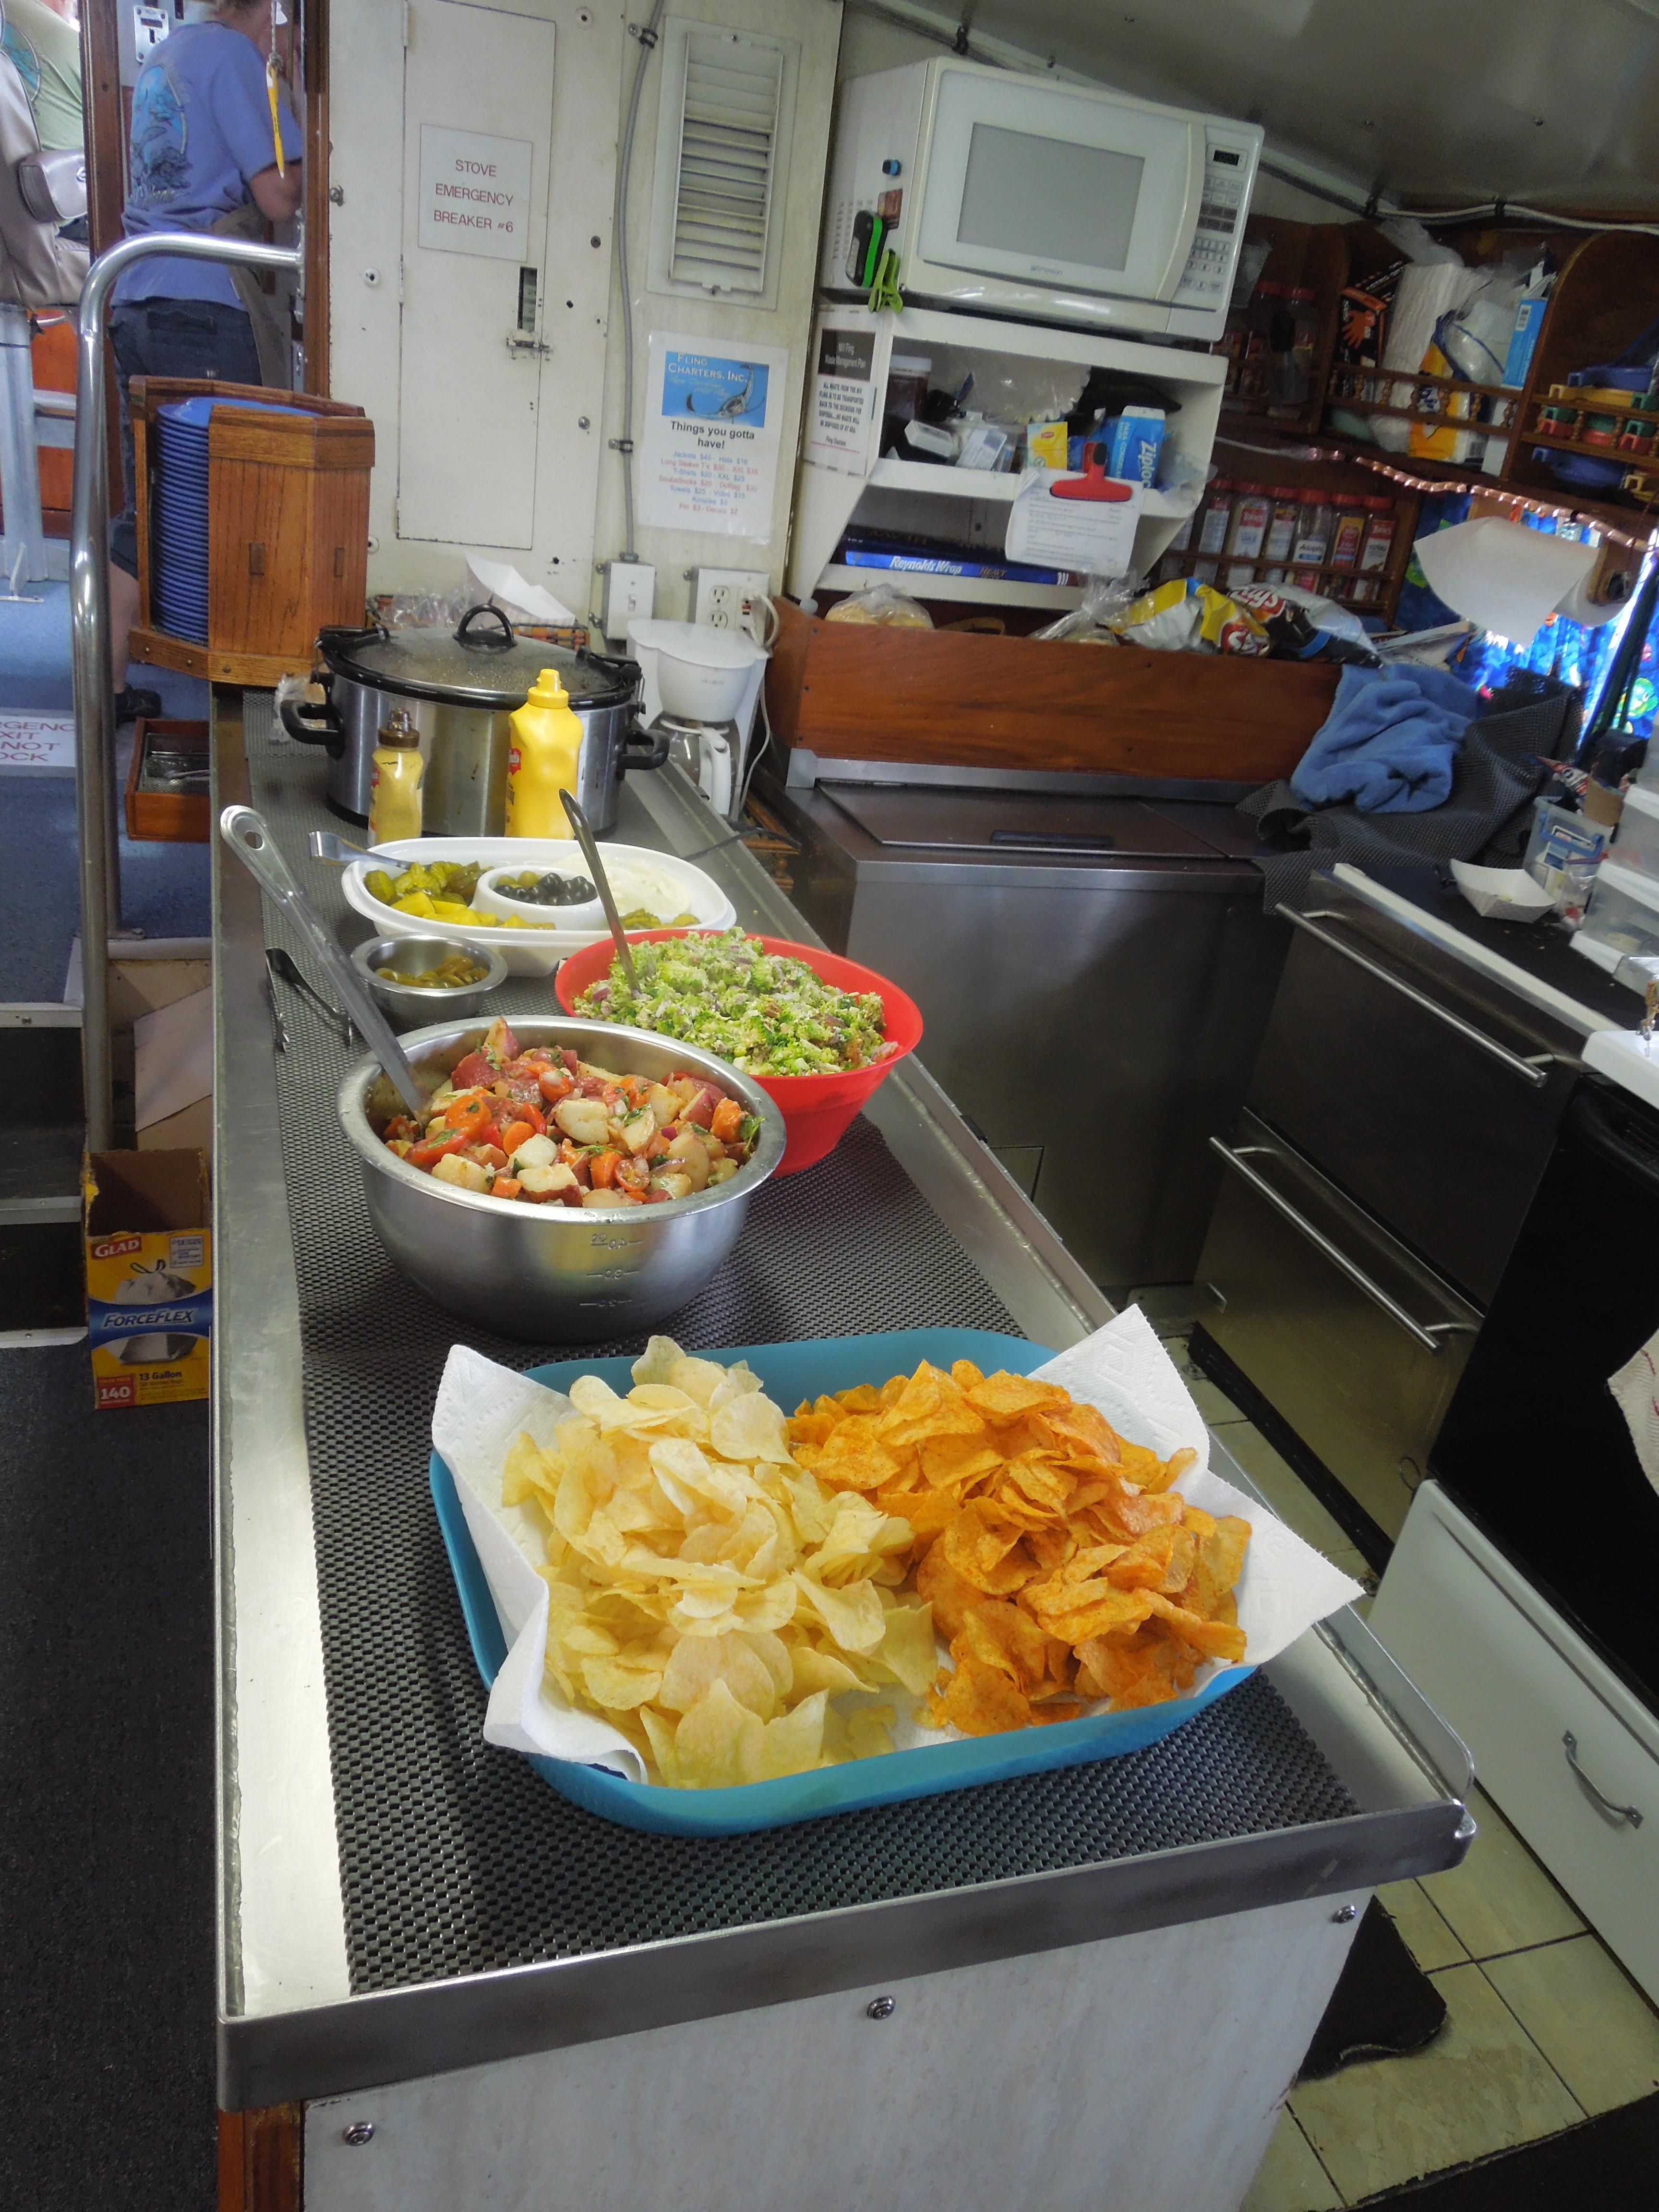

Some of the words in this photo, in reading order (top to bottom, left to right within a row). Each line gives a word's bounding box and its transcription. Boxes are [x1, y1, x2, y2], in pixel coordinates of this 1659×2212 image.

[455, 159, 497, 177] STOVE
[435, 182, 514, 206] EMERGENCY
[433, 209, 492, 229] BREAKER
[497, 221, 514, 233] #6
[671, 421, 705, 435] Things
[708, 427, 726, 436] you
[729, 430, 755, 439] gotta
[697, 437, 725, 448] have!
[1138, 440, 1157, 488] Ziploc
[889, 555, 936, 573] Reynolds
[937, 559, 963, 576] Wrap
[0, 721, 75, 731] GENC
[0, 741, 60, 750] NOT
[95, 1240, 140, 1258] GLAD
[139, 1373, 150, 1381] 13
[152, 1370, 182, 1380] Gallon
[100, 1386, 131, 1400] 140
